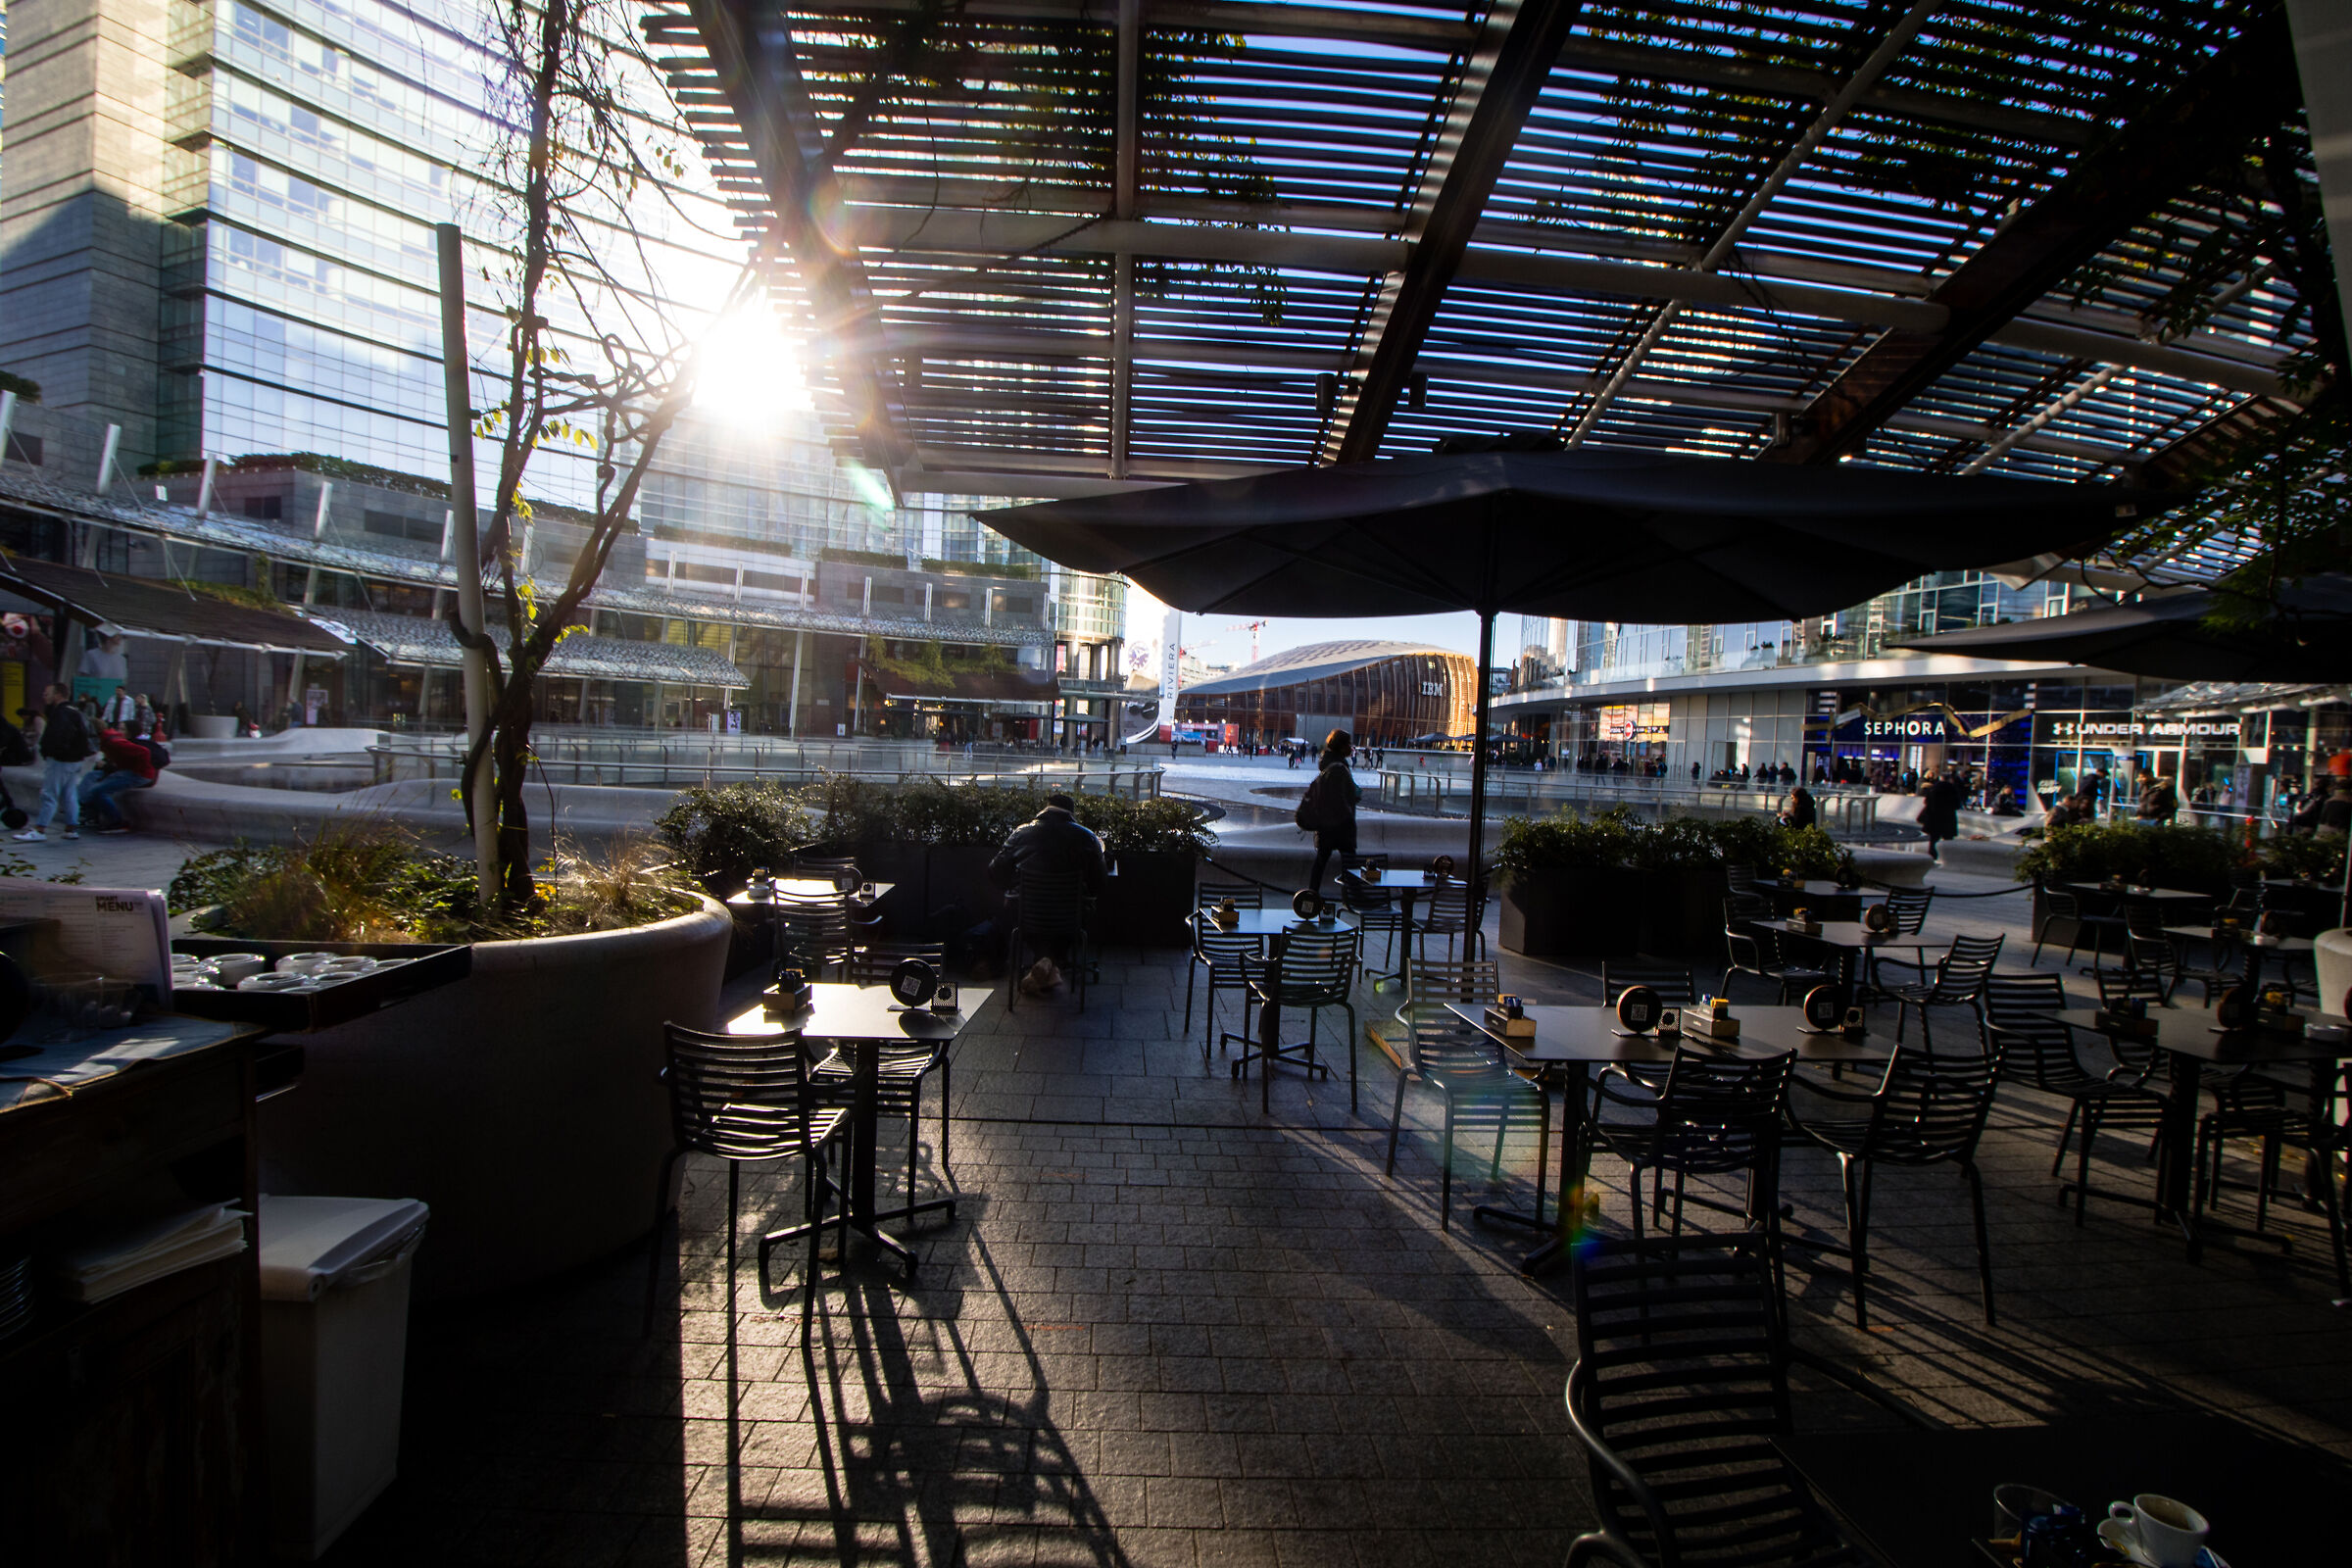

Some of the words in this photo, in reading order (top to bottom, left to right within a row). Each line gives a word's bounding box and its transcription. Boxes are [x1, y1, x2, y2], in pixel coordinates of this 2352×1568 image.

[1167, 643, 1176, 700] RIVIERA
[1422, 681, 1443, 697] IBM
[1864, 720, 1945, 736] SEPHORA
[2077, 722, 2144, 735] UNDER
[2149, 722, 2242, 736] ARMOUR
[96, 902, 134, 912] MENU
